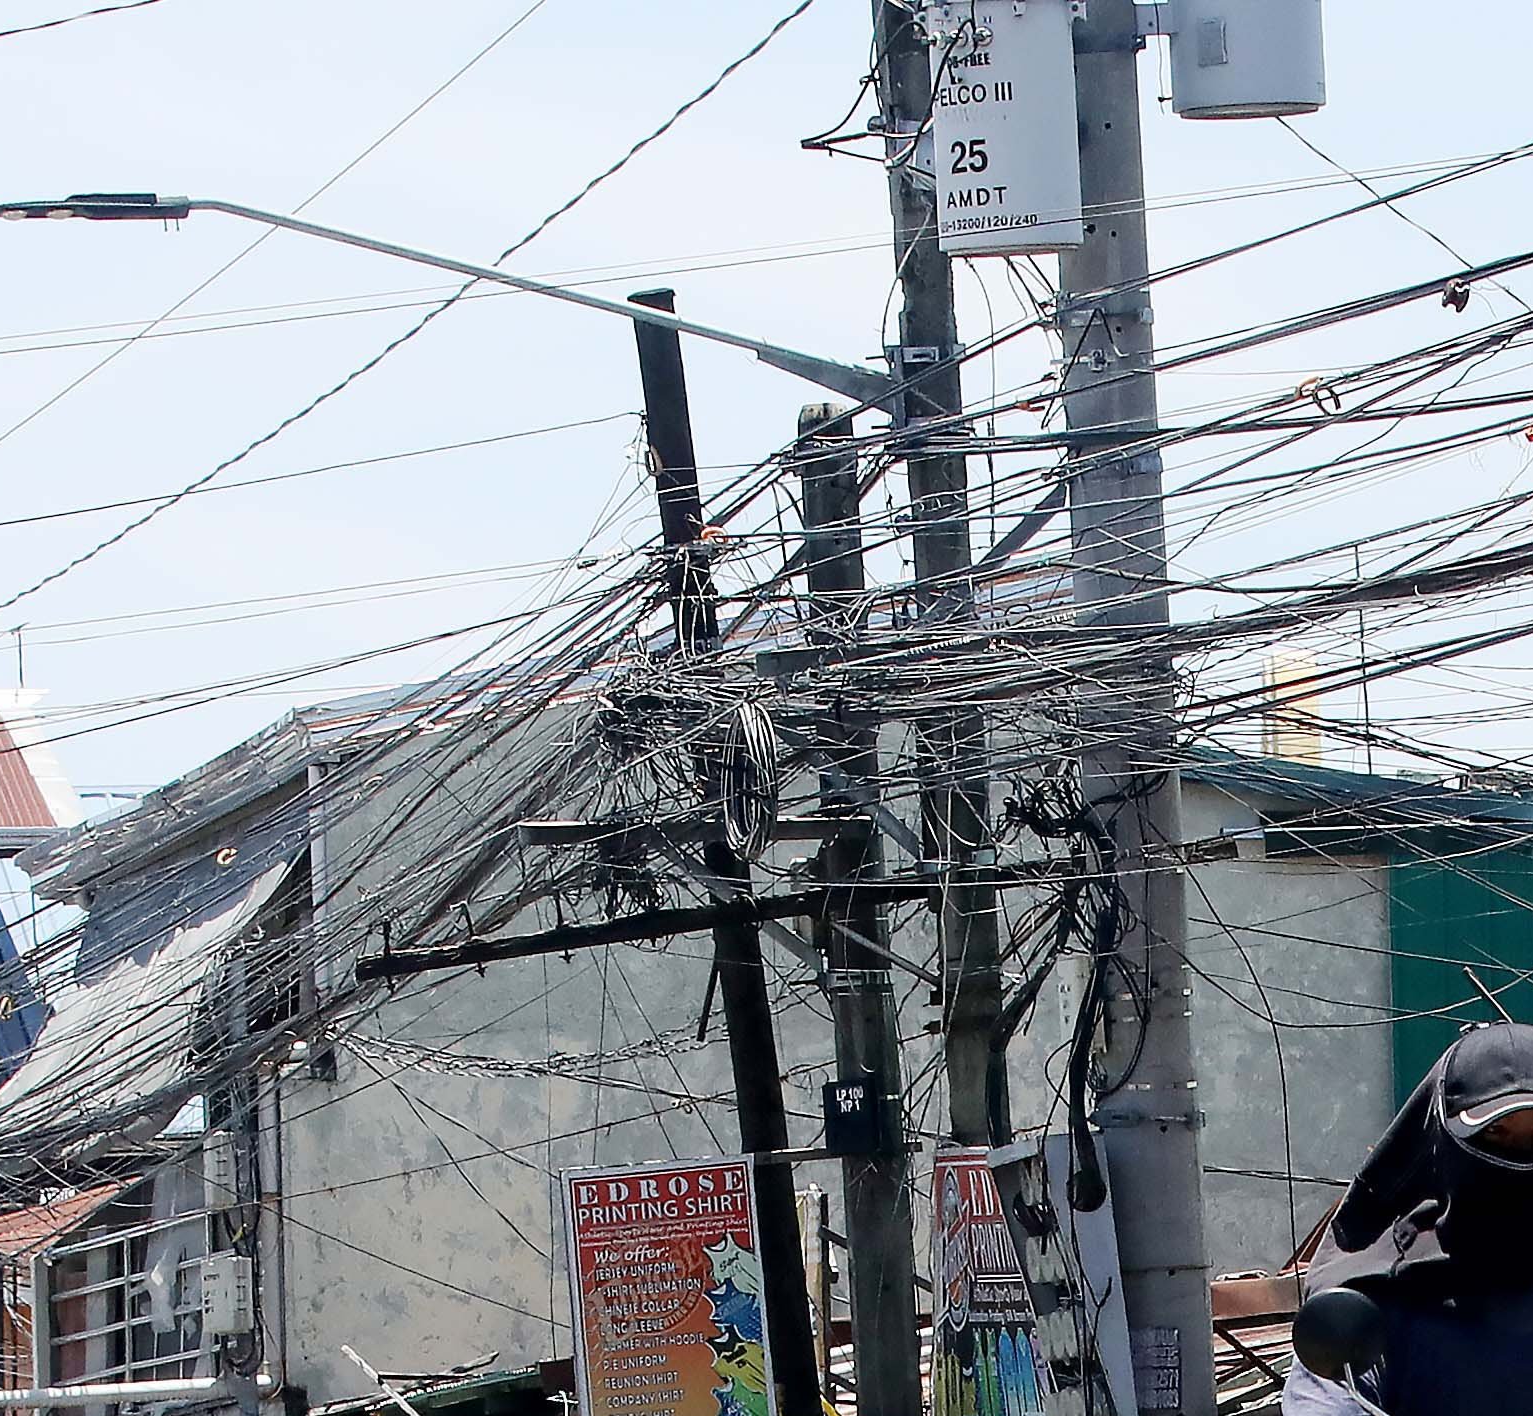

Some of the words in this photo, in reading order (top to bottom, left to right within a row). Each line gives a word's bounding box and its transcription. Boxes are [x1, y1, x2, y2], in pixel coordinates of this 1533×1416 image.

[994, 81, 1013, 102] III
[950, 139, 988, 175] 25
[947, 186, 1008, 209] AMDT
[836, 1089, 847, 1101] LP
[848, 1086, 864, 1100] 100
[840, 1100, 853, 1113] NP
[577, 1169, 745, 1206] EDROSE
[968, 1169, 1004, 1217] ED
[578, 1199, 679, 1226] PRINTING
[685, 1192, 746, 1217] SHIRT
[594, 1249, 620, 1265] We
[624, 1244, 670, 1263] offer:
[595, 1267, 629, 1282] JERSEY
[630, 1261, 677, 1278] UNIFORM
[635, 1278, 702, 1296] SUBLIMATION
[641, 1298, 680, 1314] COLLAR
[643, 1336, 667, 1349] WITH
[668, 1332, 705, 1347] HOODIE
[621, 1354, 668, 1371] UNIFORM
[603, 1375, 650, 1390] REUNION
[651, 1371, 679, 1385] SHIRT
[606, 1394, 655, 1410] COMPANY
[656, 1389, 685, 1404] SHIRT
